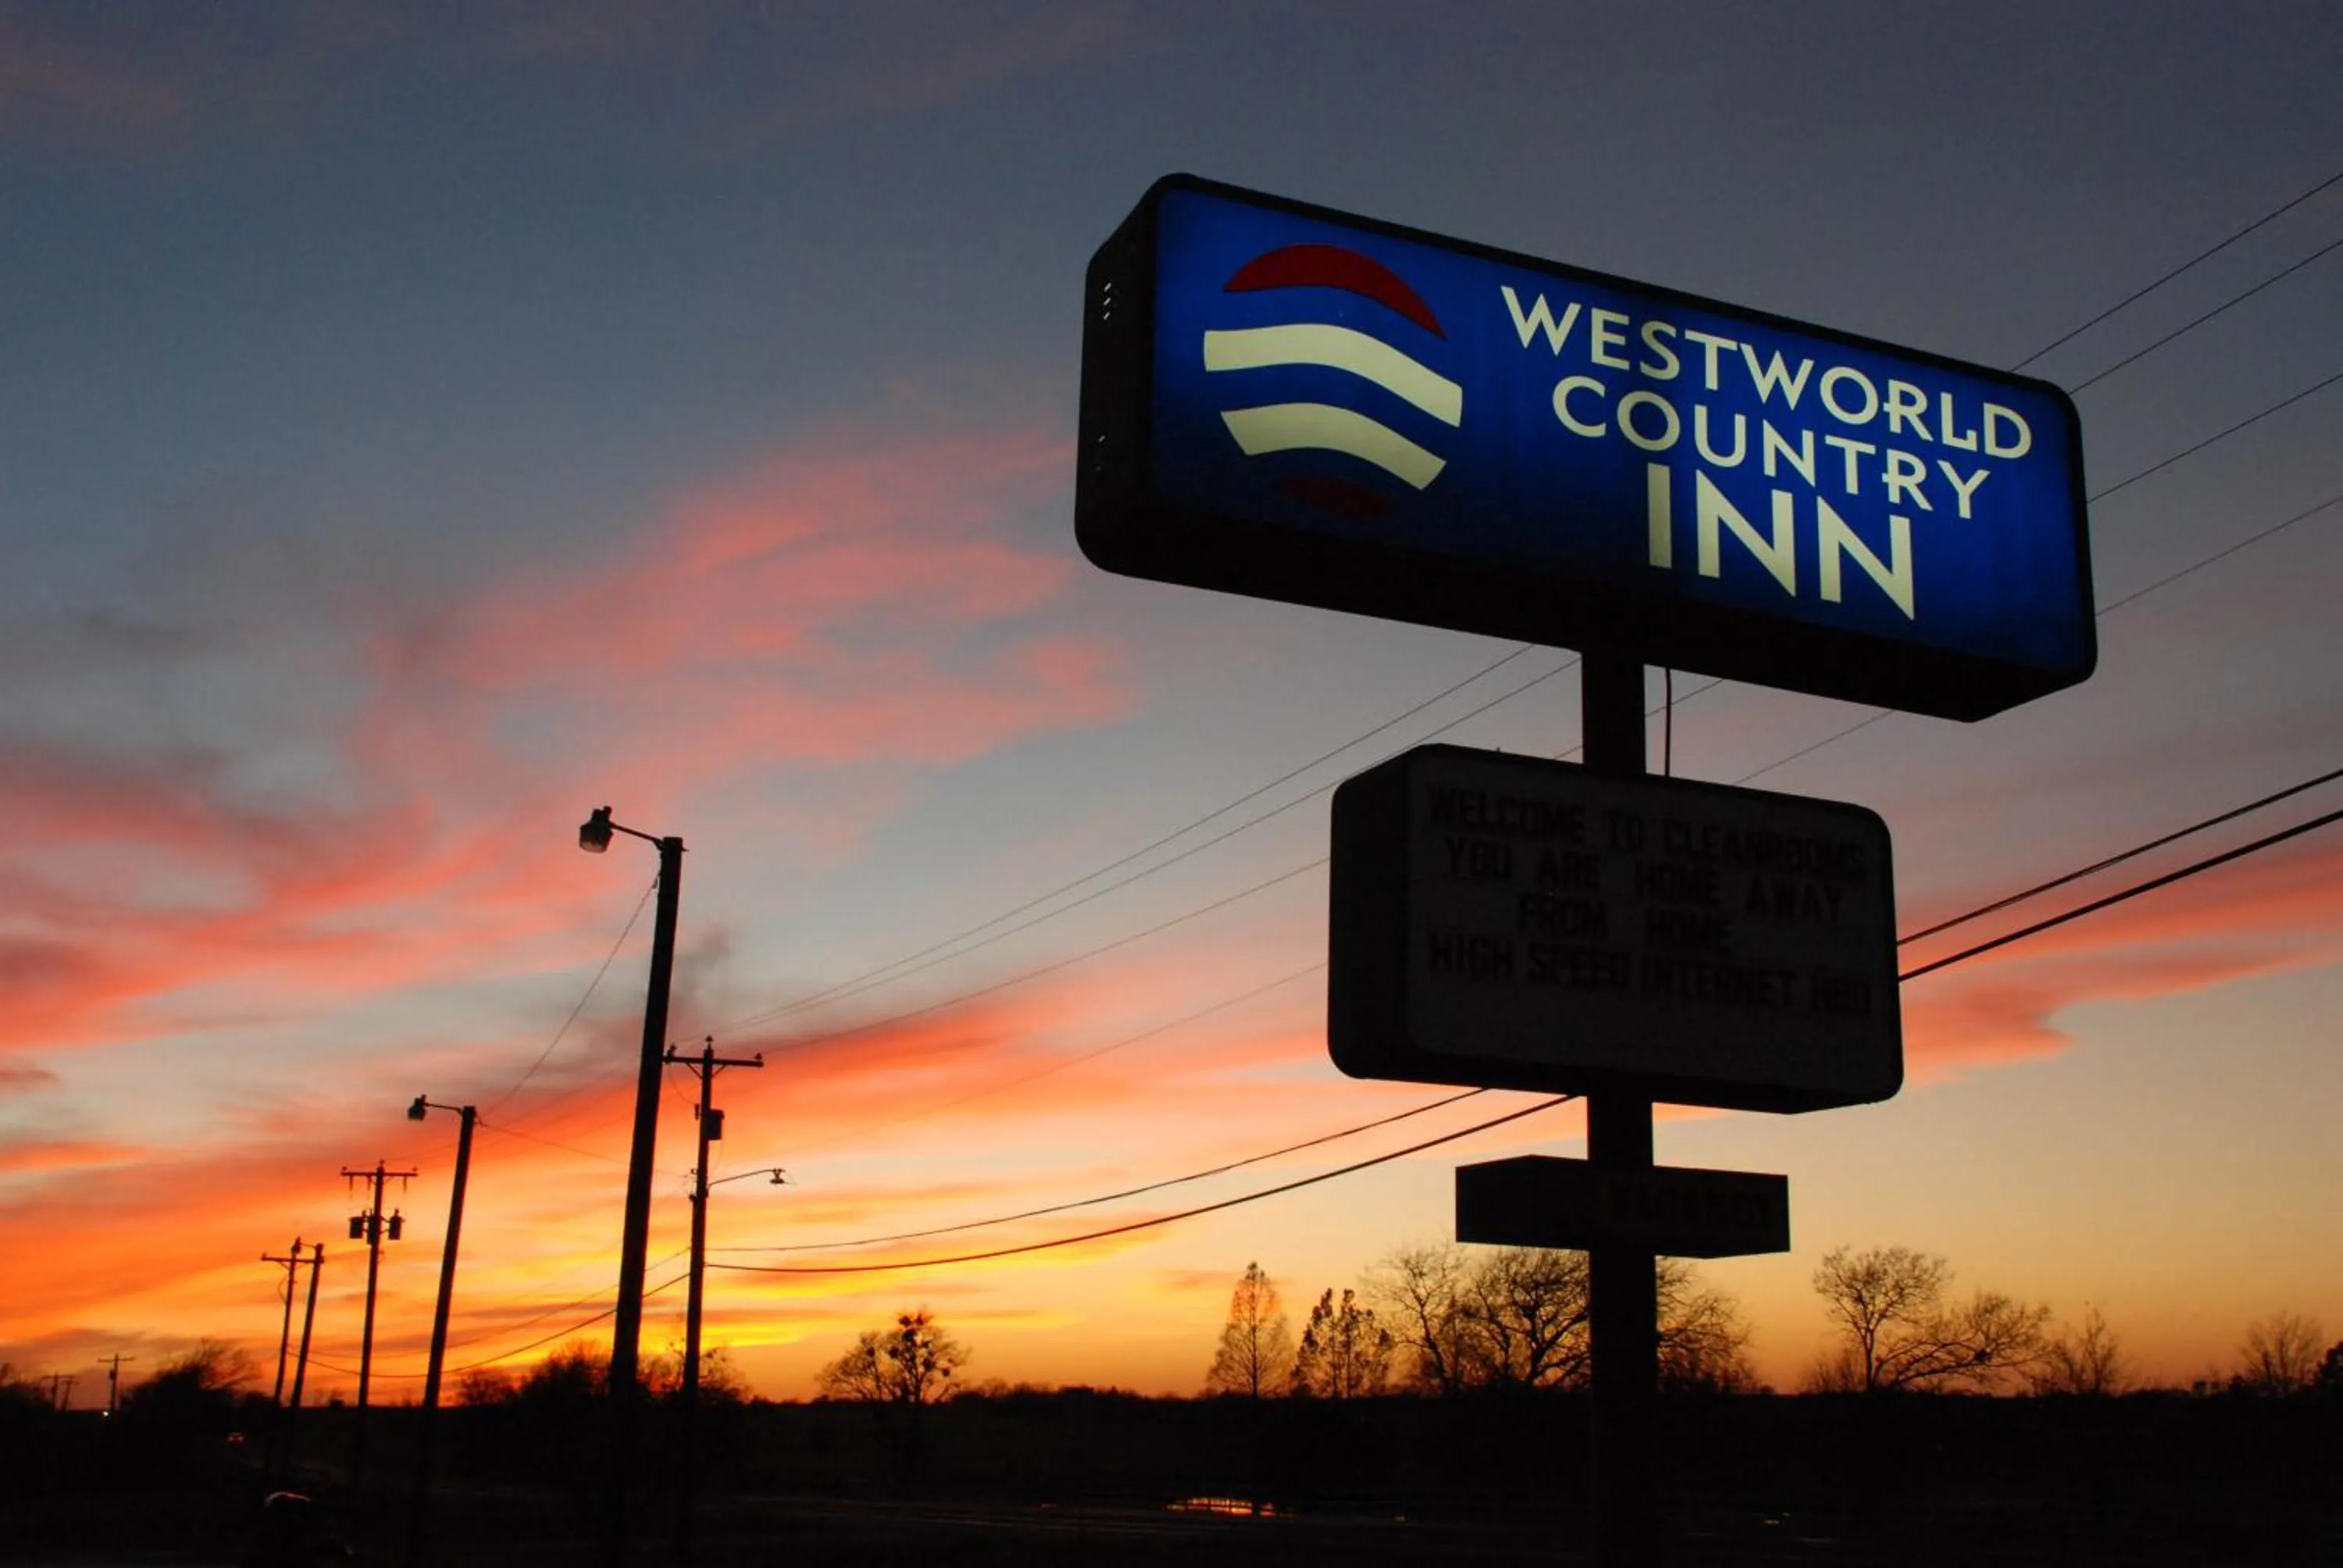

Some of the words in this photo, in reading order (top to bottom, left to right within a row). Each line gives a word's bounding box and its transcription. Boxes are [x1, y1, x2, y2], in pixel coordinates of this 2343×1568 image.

[1501, 286, 2032, 459] WESTWORLD
[1553, 376, 1990, 519] COUNTRY
[1648, 462, 1914, 620] INN
[1429, 786, 1585, 843] WELCOME
[1603, 809, 1644, 852] TO
[1446, 836, 1511, 880] YOU
[1537, 850, 1600, 890] ARE
[1635, 860, 1719, 906] HOME
[1746, 875, 1842, 921] AWAY
[1518, 894, 1608, 939] FROM
[1645, 908, 1731, 953] HOME
[1429, 932, 1514, 981] HIGH
[1526, 942, 1629, 987] SPEED
[1642, 955, 1797, 1007] INTERNET
